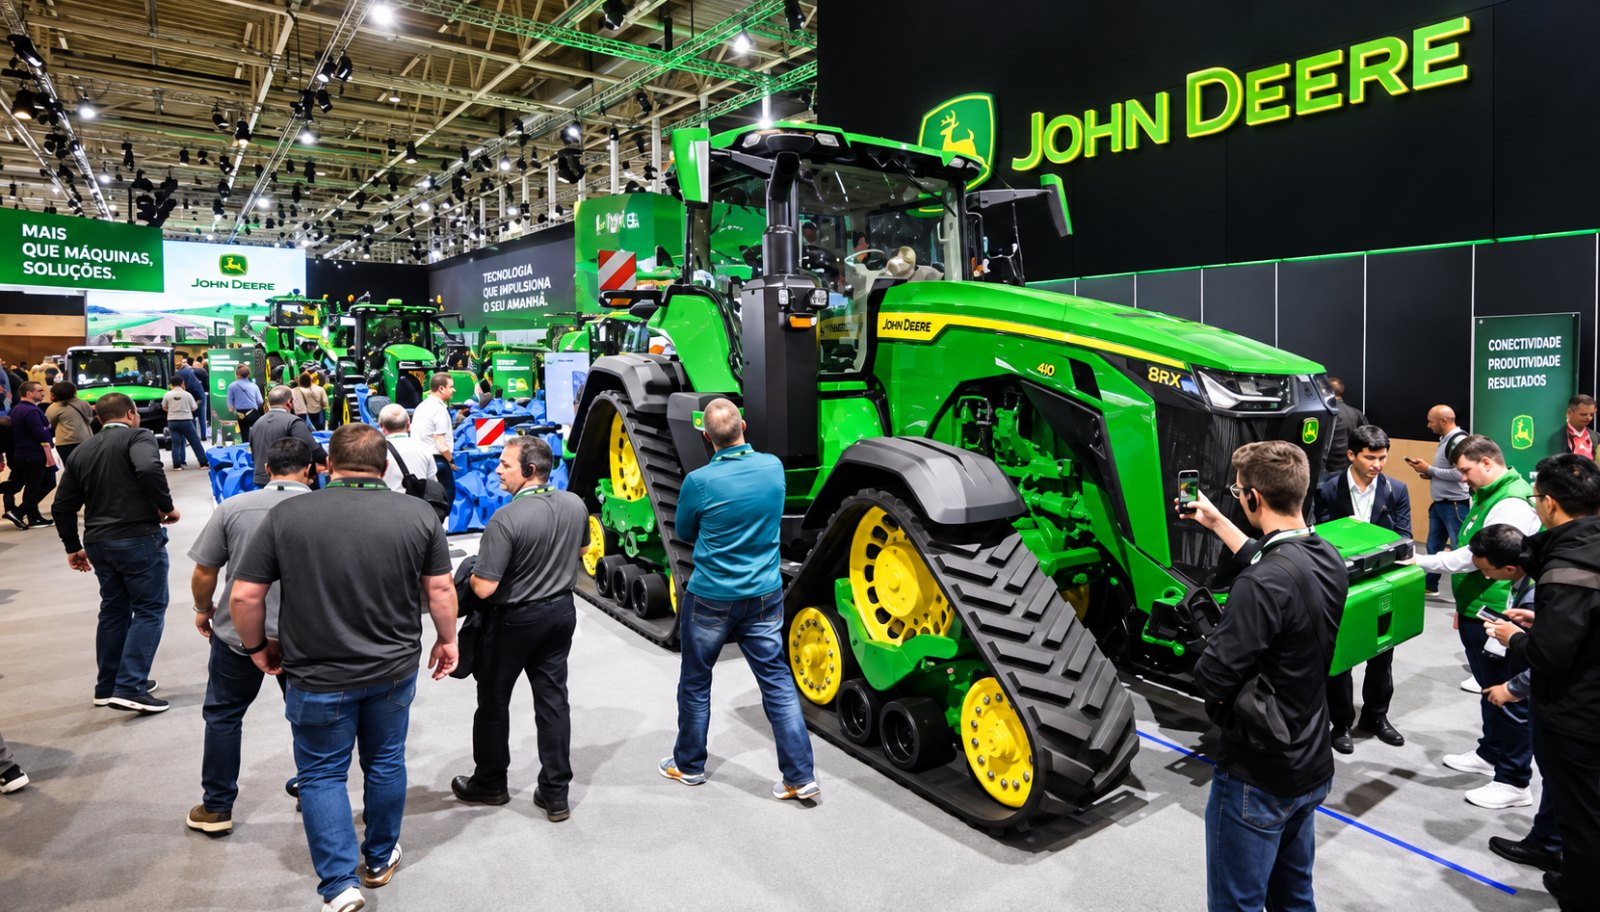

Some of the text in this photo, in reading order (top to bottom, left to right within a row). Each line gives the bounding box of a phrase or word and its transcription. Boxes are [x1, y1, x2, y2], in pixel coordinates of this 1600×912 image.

[1011, 16, 1470, 172] JOHN DEERE
[22, 223, 67, 241] MAIS
[22, 242, 154, 267] QUE MÁQUINAS,
[22, 261, 116, 281] SOLUÇÕES.
[191, 277, 276, 291] JOHN DEERE
[483, 276, 551, 299] QUE IMPULSIONA
[483, 302, 490, 313] O
[491, 299, 505, 312] SEU
[882, 318, 932, 333] JOHN DEERE
[1488, 336, 1562, 351] CONECTIVIDADE
[1036, 362, 1055, 377] 410
[1488, 355, 1561, 370] PRODUTIVIDADE
[1147, 366, 1182, 388] 8RX
[1488, 374, 1546, 390] RESULTADOS
